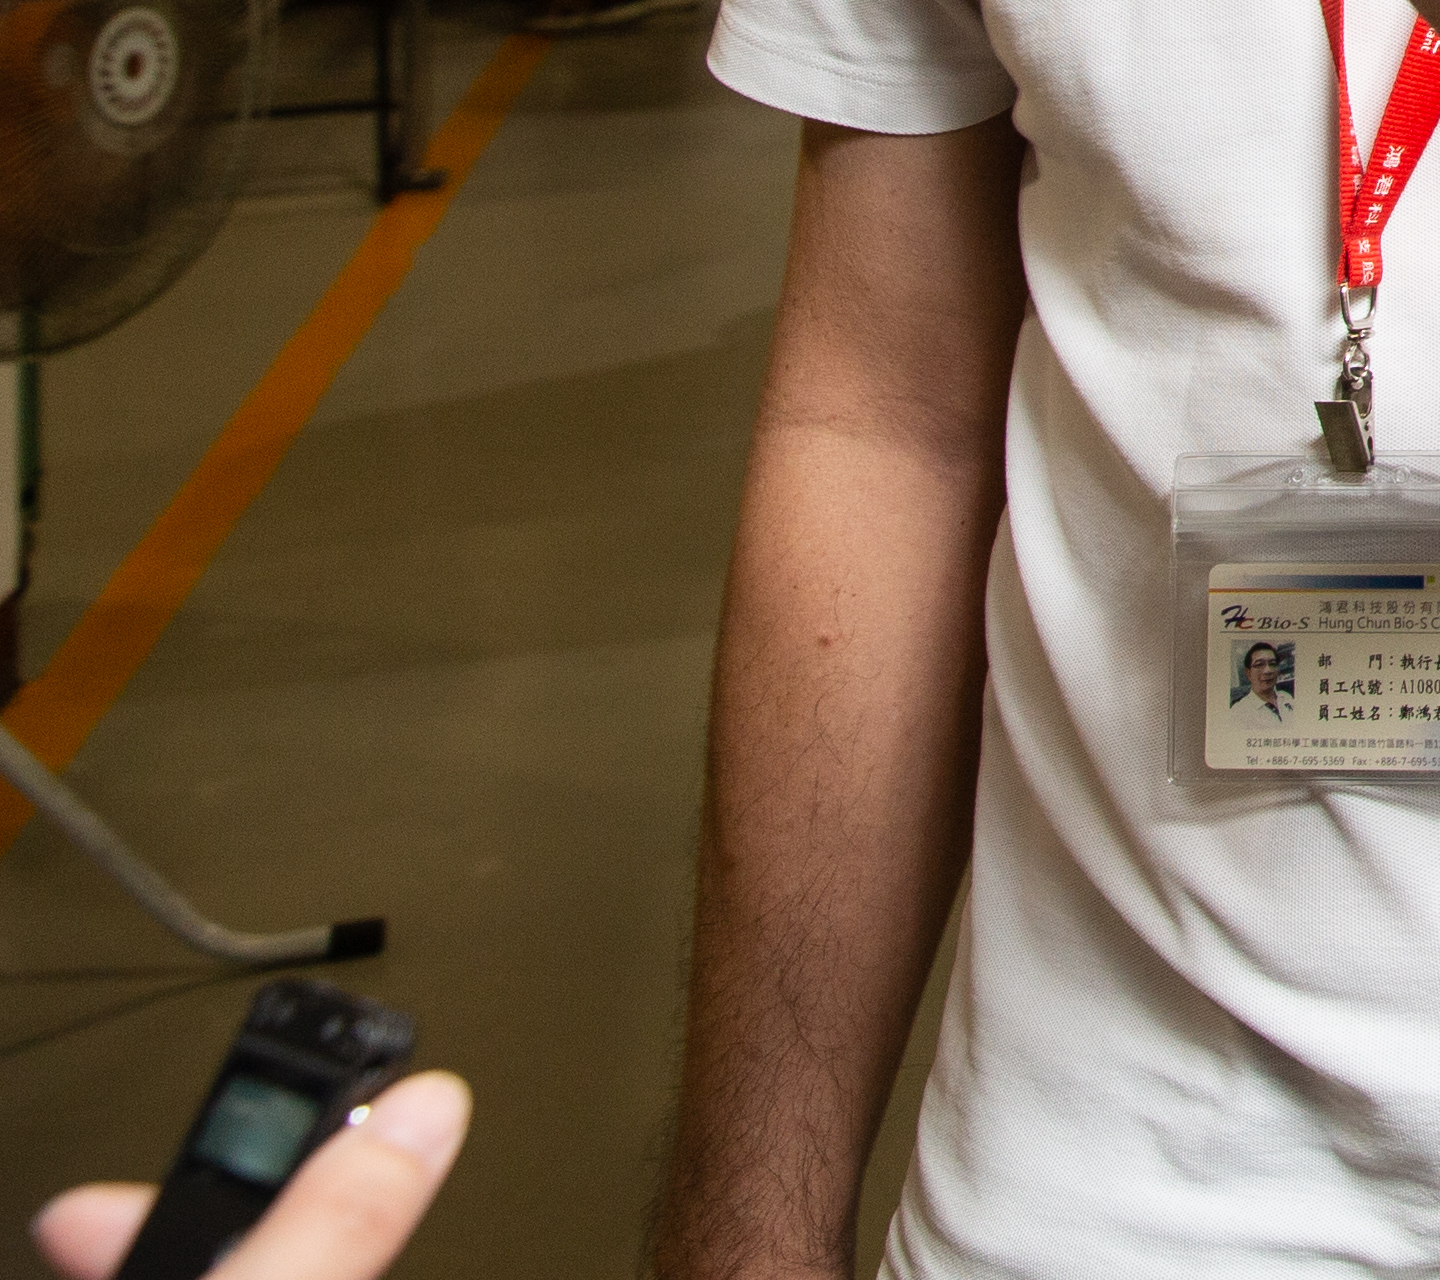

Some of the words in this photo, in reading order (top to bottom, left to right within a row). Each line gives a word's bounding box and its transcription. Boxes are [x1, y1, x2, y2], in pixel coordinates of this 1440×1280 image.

[1257, 616, 1310, 630] Bio-S
[1319, 616, 1353, 632] Hung
[1357, 616, 1391, 630] Chun
[1394, 616, 1428, 630] Bio-S
